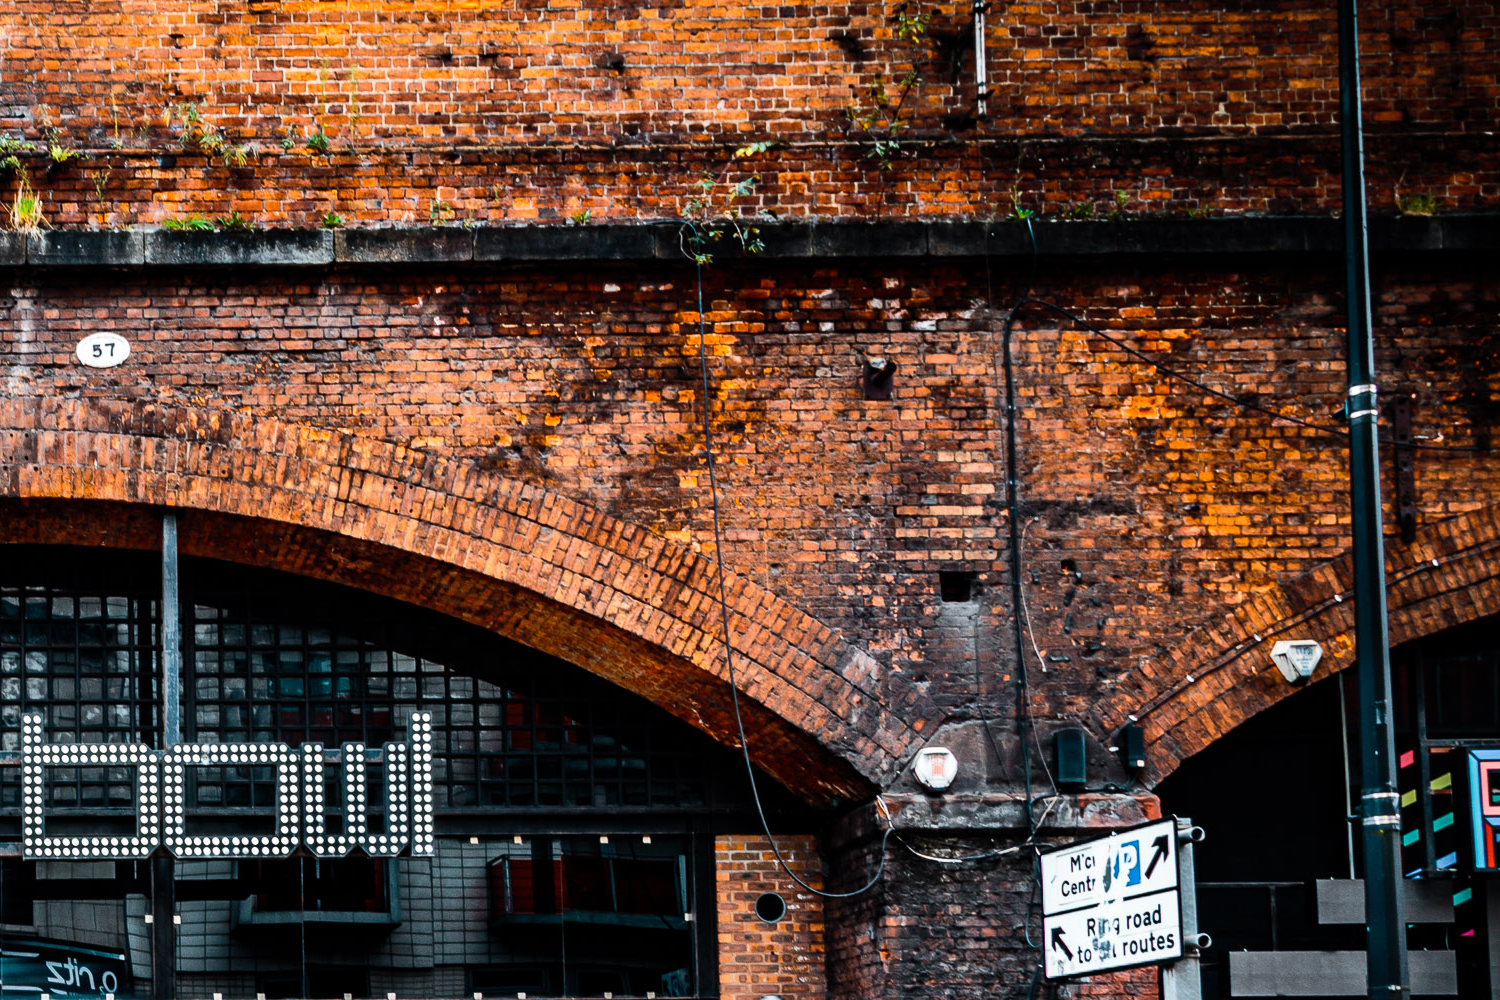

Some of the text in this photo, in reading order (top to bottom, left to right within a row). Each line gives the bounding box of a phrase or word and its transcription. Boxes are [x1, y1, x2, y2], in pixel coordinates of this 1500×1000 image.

[92, 342, 116, 358] 57
[22, 711, 434, 859] bowl
[1061, 875, 1096, 897] Centr
[1126, 904, 1162, 930] road
[1077, 945, 1092, 964] to
[1123, 932, 1175, 957] routes
